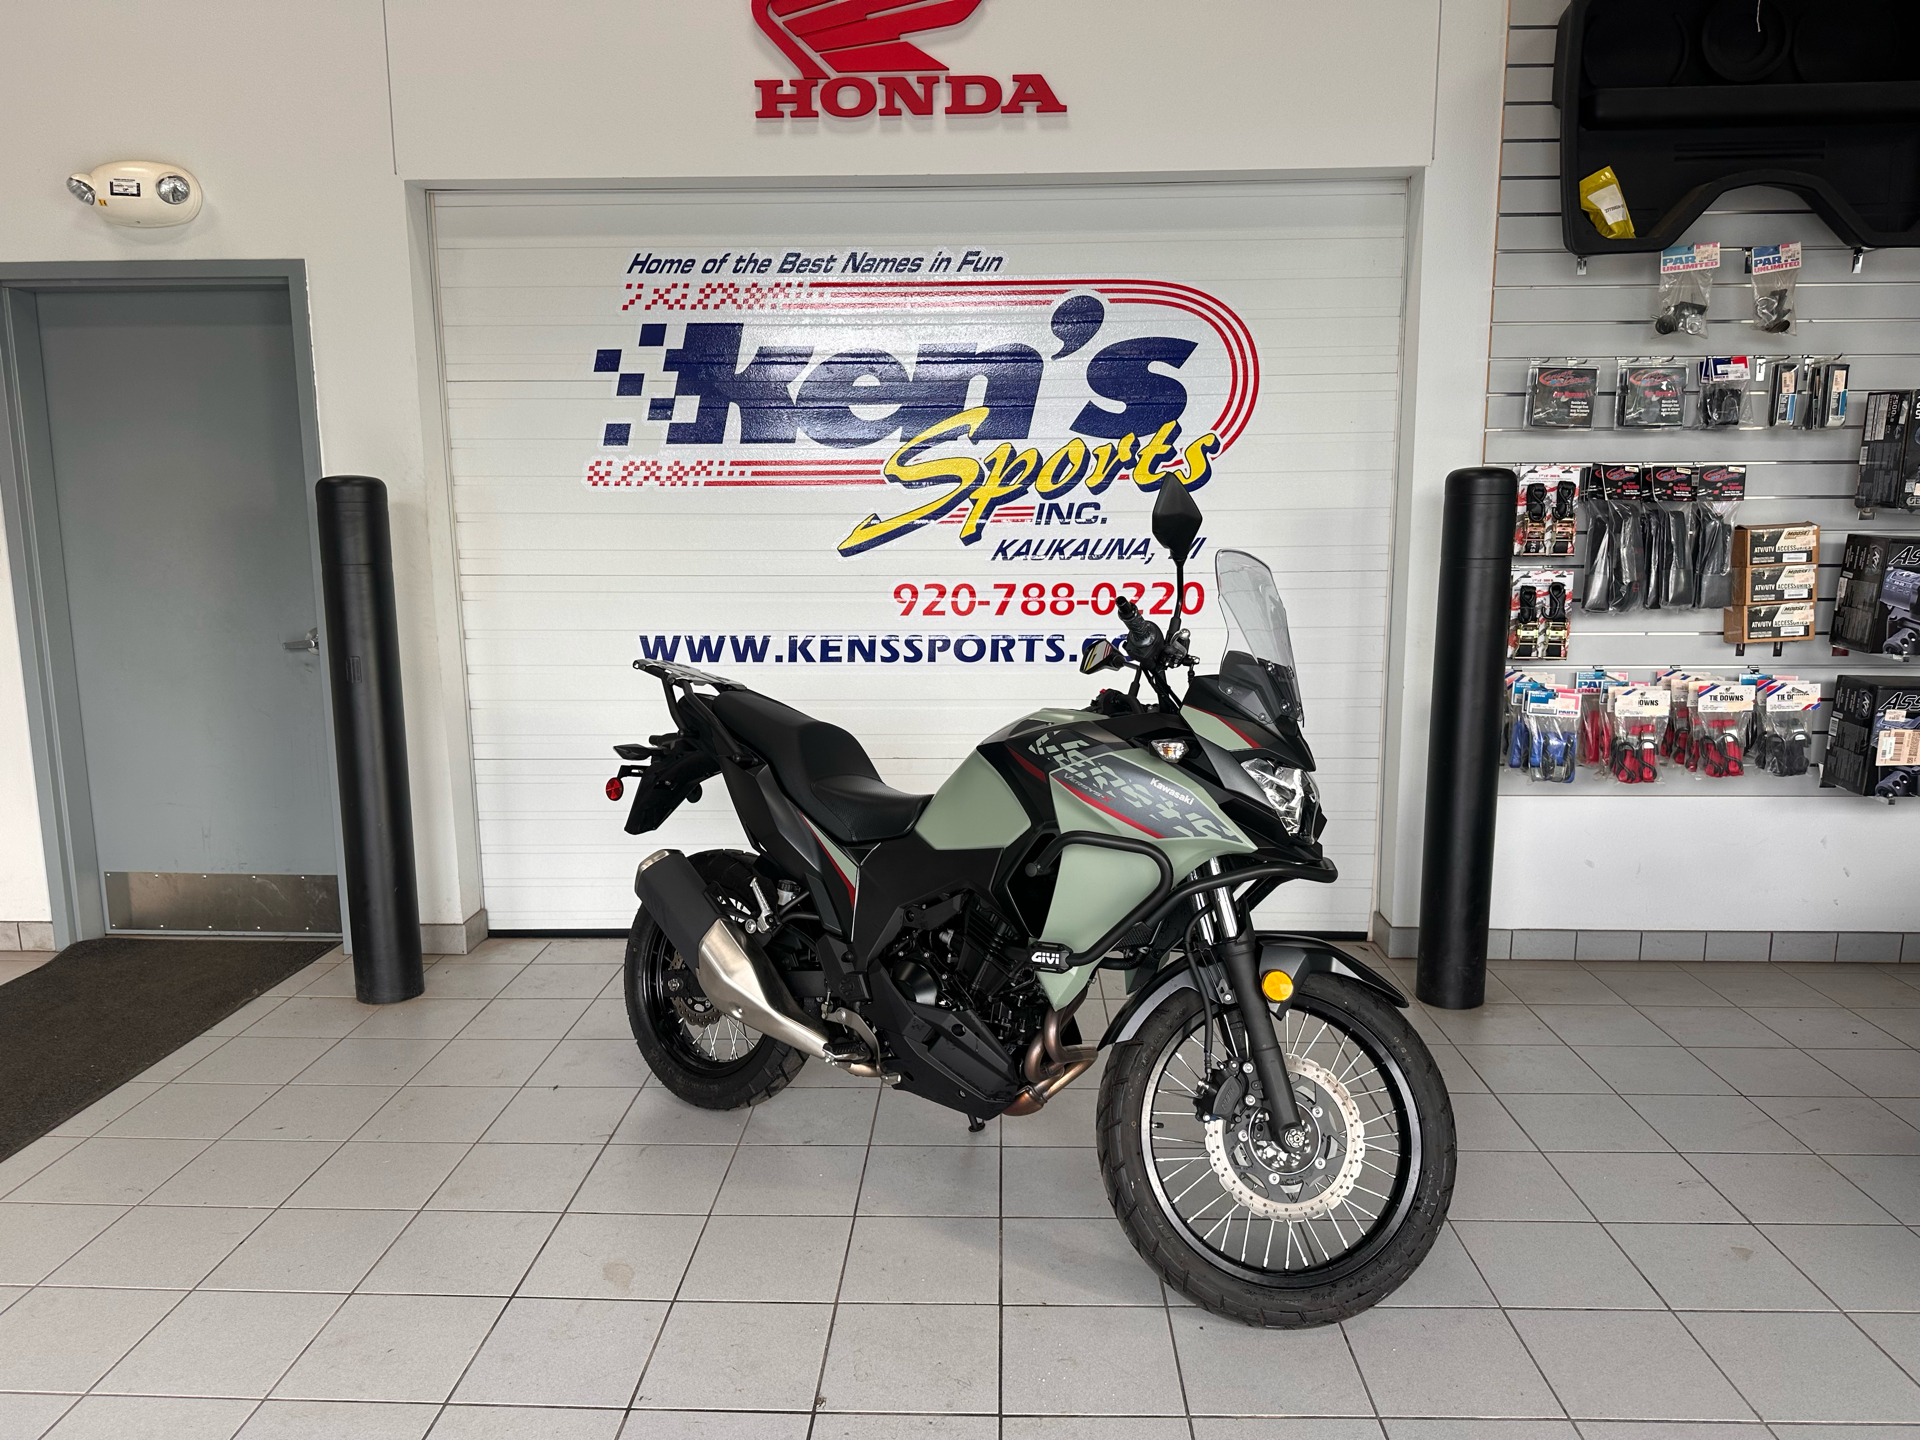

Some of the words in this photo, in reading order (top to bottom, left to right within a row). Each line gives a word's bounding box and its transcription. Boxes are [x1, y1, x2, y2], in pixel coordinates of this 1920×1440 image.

[754, 74, 1067, 118] HONDA
[627, 253, 696, 274] Home
[701, 253, 731, 274] of
[732, 252, 772, 274] the
[777, 252, 838, 274] Best
[841, 252, 924, 273] Names
[929, 251, 952, 273] in
[956, 251, 1003, 272] Fun
[1662, 255, 1718, 267] PAR
[1662, 261, 1718, 272] UNLIMITED
[1754, 261, 1800, 273] UNLIMITED
[664, 295, 1198, 448] ken's
[837, 406, 1221, 557] Sports
[1035, 502, 1107, 525] INC.
[991, 537, 1155, 564] KAUKAUNA,
[1754, 545, 1775, 553] ATV/UTV
[1754, 583, 1775, 591] ATV/UTV
[893, 581, 1205, 616] 920-788-0220
[1751, 620, 1772, 628] ATV/UTV
[1637, 699, 1659, 707] OWNS
[1719, 694, 1744, 702] DOWNS
[1777, 693, 1786, 701] TIE
[1150, 777, 1195, 806] Kawasaki
[1031, 951, 1060, 965] GIVI
